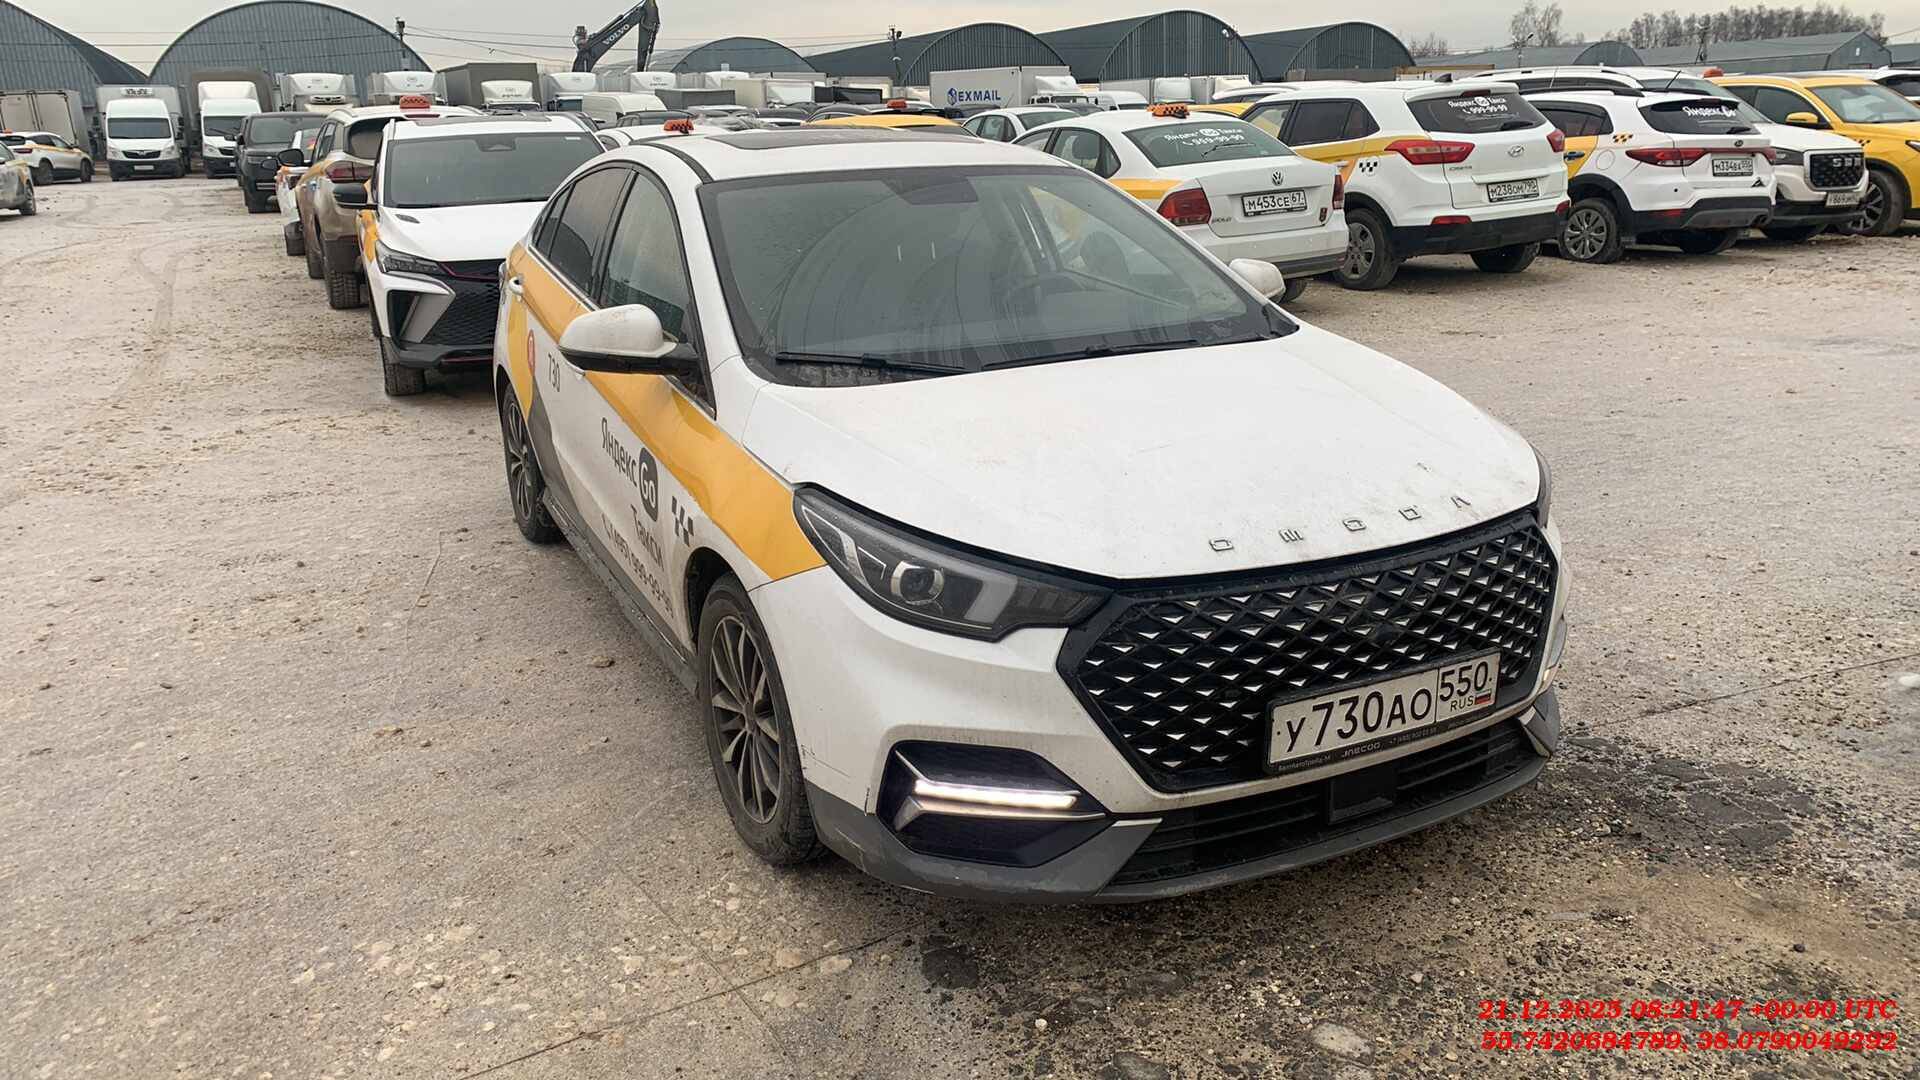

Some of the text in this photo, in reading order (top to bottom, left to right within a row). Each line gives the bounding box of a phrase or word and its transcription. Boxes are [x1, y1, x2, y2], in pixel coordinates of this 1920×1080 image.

[602, 24, 630, 45] VOLVO
[957, 89, 1002, 102] EXMAIL
[1291, 192, 1301, 202] 67
[601, 417, 656, 509] Яндекс Go
[630, 503, 664, 573] Такси
[1208, 495, 1471, 551] OMODA
[1439, 661, 1488, 702] 550
[1450, 695, 1474, 712] RUS
